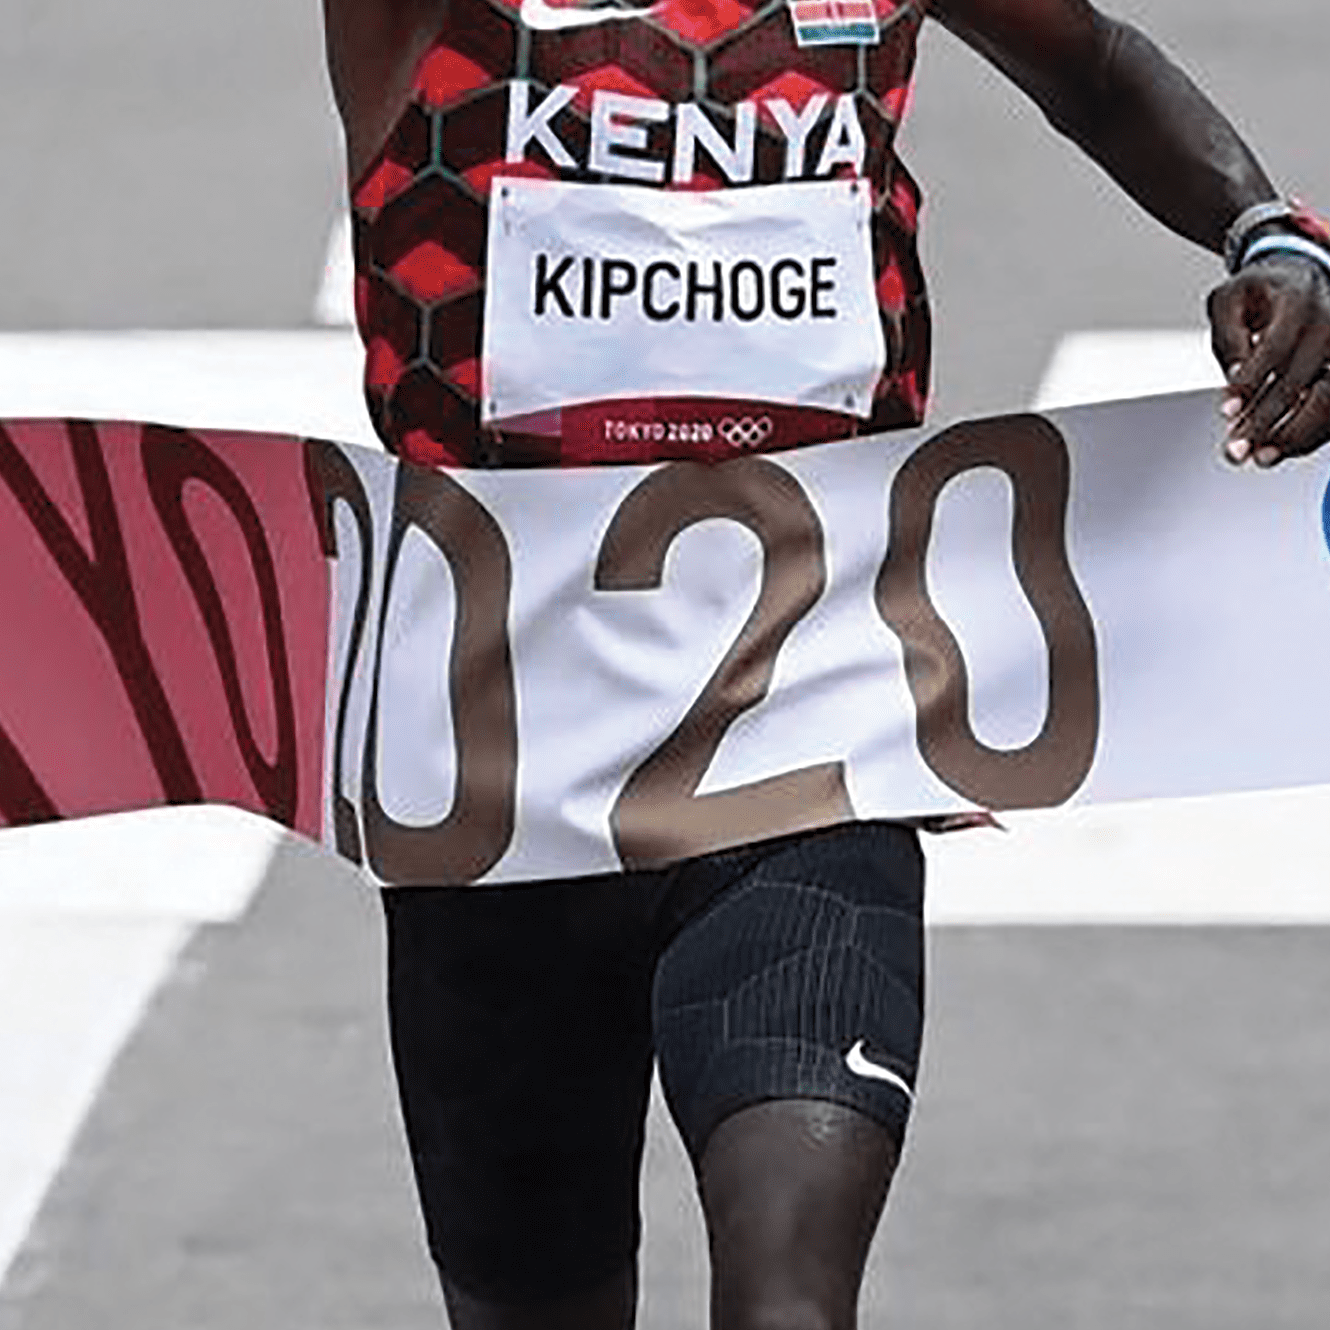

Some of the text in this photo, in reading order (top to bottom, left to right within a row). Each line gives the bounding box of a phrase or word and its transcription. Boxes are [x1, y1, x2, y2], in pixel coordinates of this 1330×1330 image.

[503, 80, 866, 183] KENYA
[533, 254, 838, 322] KIPCHOGE
[604, 420, 714, 442] TOKYO 2020
[303, 412, 1100, 887] 2020
